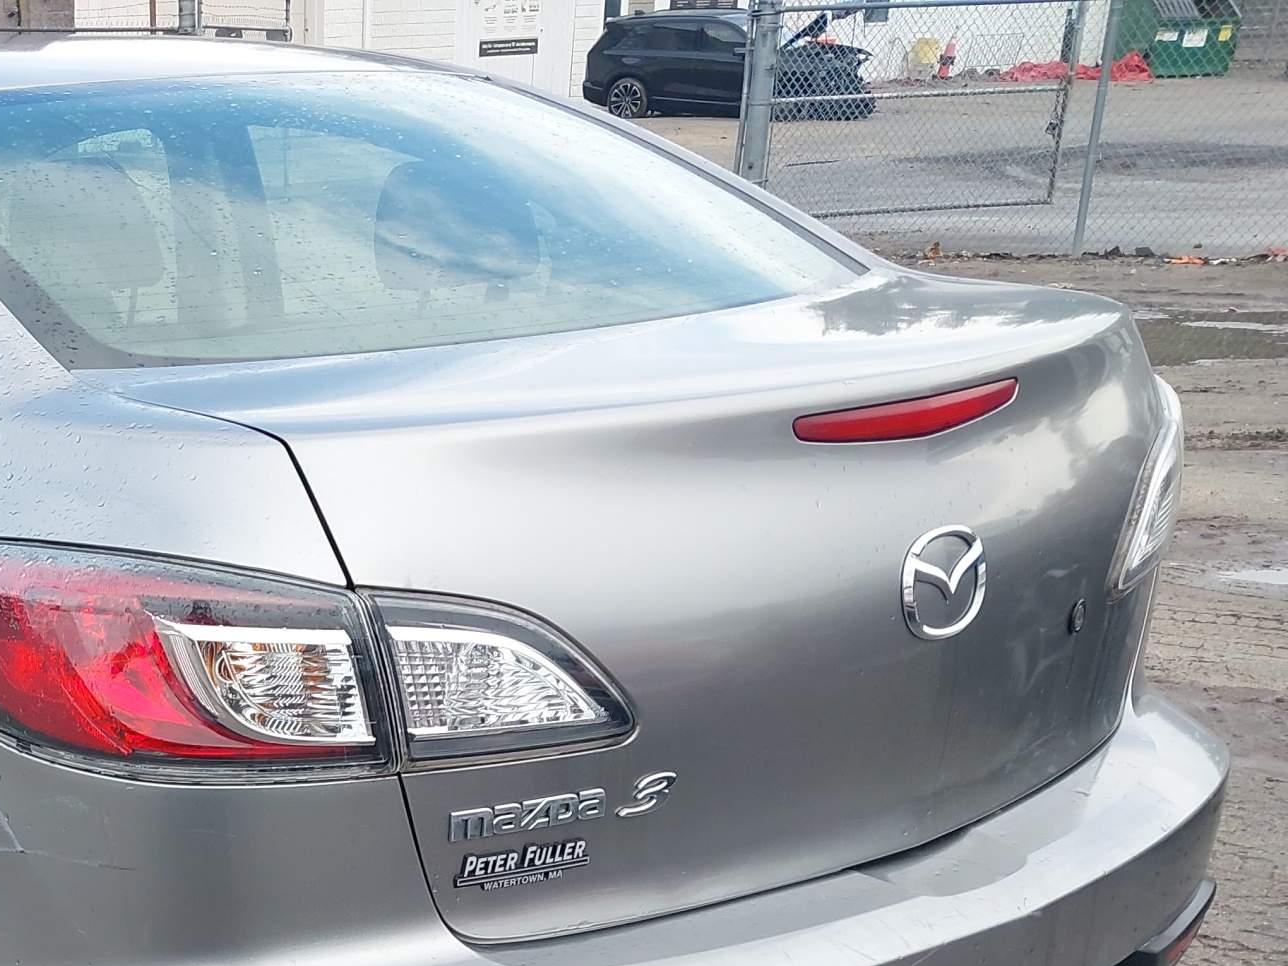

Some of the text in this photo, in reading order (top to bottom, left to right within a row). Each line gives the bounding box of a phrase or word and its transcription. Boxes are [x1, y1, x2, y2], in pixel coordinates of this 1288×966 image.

[615, 771, 677, 818] 3
[463, 840, 587, 878] PETER FULLER
[483, 869, 563, 891] WATERTOWN, MA
